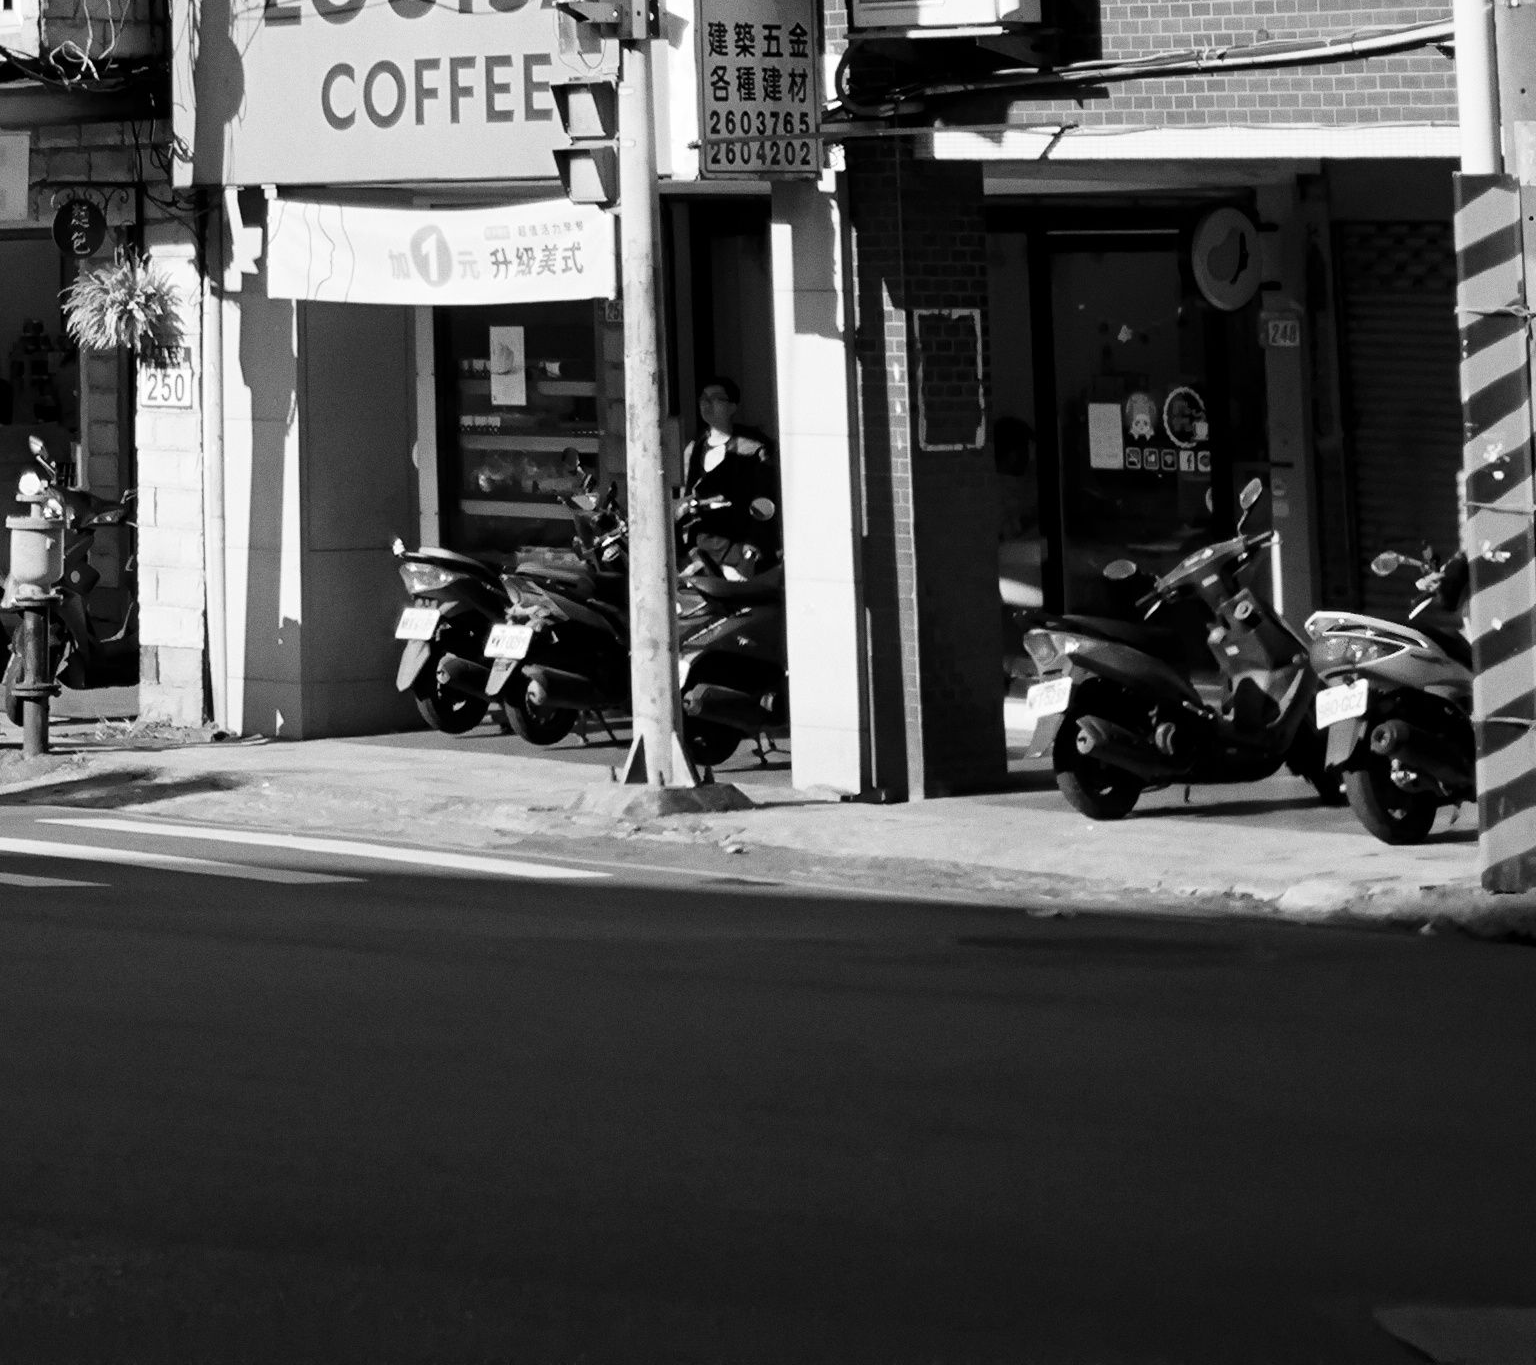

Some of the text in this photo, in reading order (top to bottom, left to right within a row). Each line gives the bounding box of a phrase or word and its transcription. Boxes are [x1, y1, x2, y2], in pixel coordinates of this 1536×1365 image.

[707, 21, 809, 58] 建築五金
[321, 52, 554, 132] COFFEE
[710, 65, 809, 103] 各種建材
[709, 109, 810, 136] 2603765
[710, 140, 811, 166] 2604202
[147, 373, 185, 402] 250
